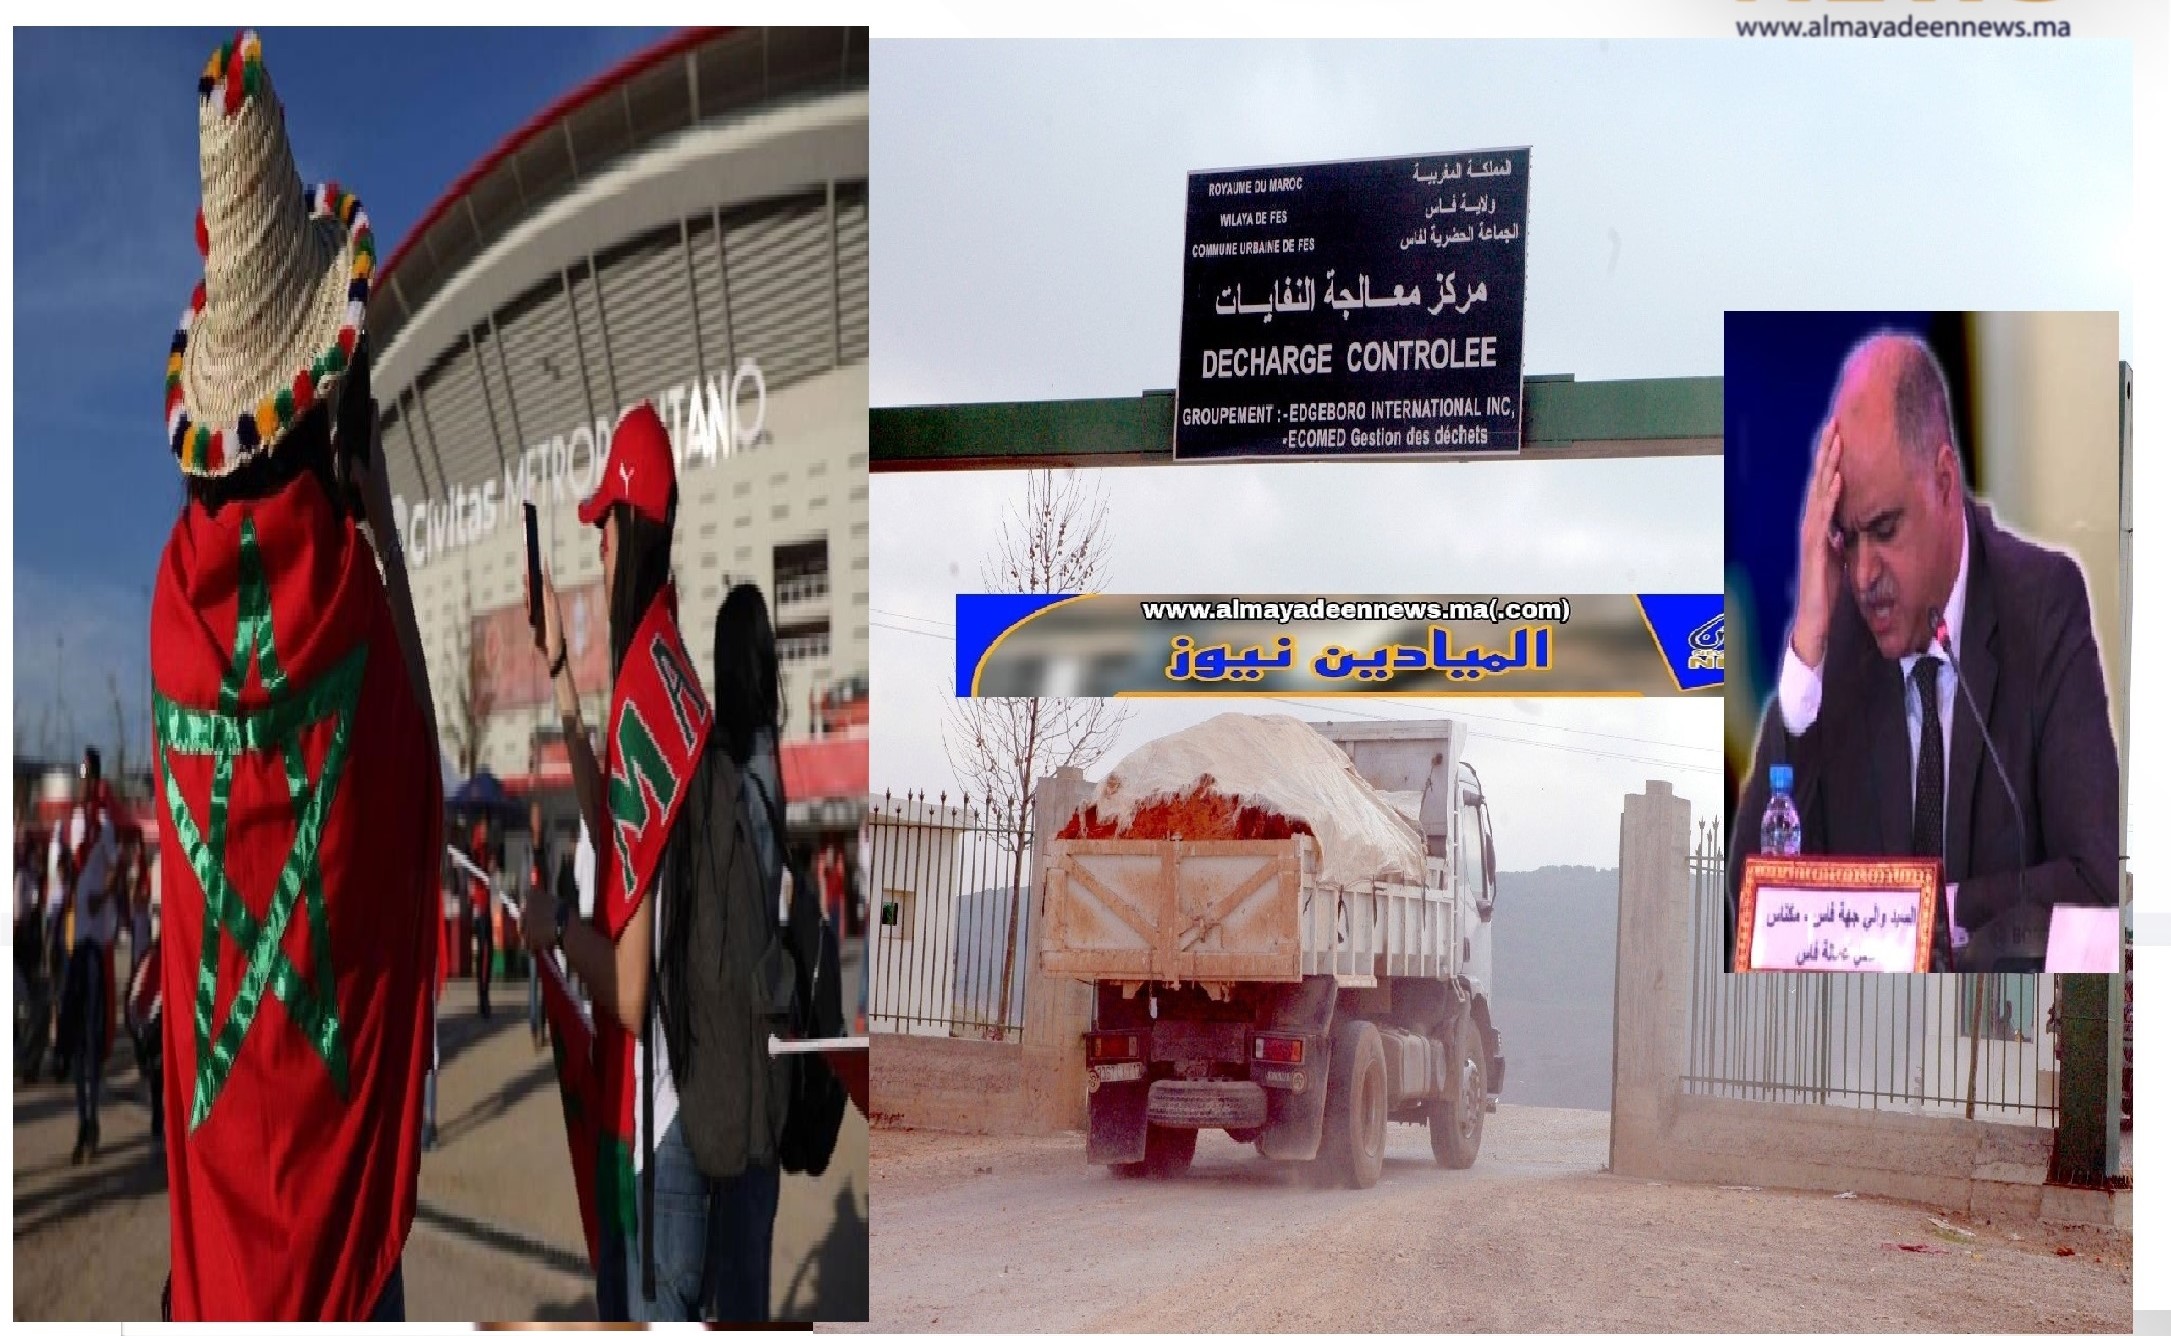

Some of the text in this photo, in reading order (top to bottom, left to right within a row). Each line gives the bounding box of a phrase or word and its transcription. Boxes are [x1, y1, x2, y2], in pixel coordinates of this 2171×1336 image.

[1412, 158, 1512, 185] المملكة المغربية
[1209, 177, 1303, 197] ROYAUME DU MAROC
[1220, 210, 1287, 227] WILAYA DE FES
[1426, 194, 1457, 218] فاس
[1191, 237, 1315, 258] COMMUNE URBAINE DE FES
[1400, 221, 1518, 250] الجماعة الحضرية لفاس
[1215, 269, 1488, 324] مركز معالجة النفايات
[1202, 336, 1498, 379] DECHARGE CONTROLEE
[1183, 404, 1273, 426] GROUPEMENT
[1371, 397, 1482, 420] INTERNATIONAL
[1350, 427, 1401, 447] Gestion
[1406, 425, 1430, 446] des
[1434, 423, 1489, 445] déchets
